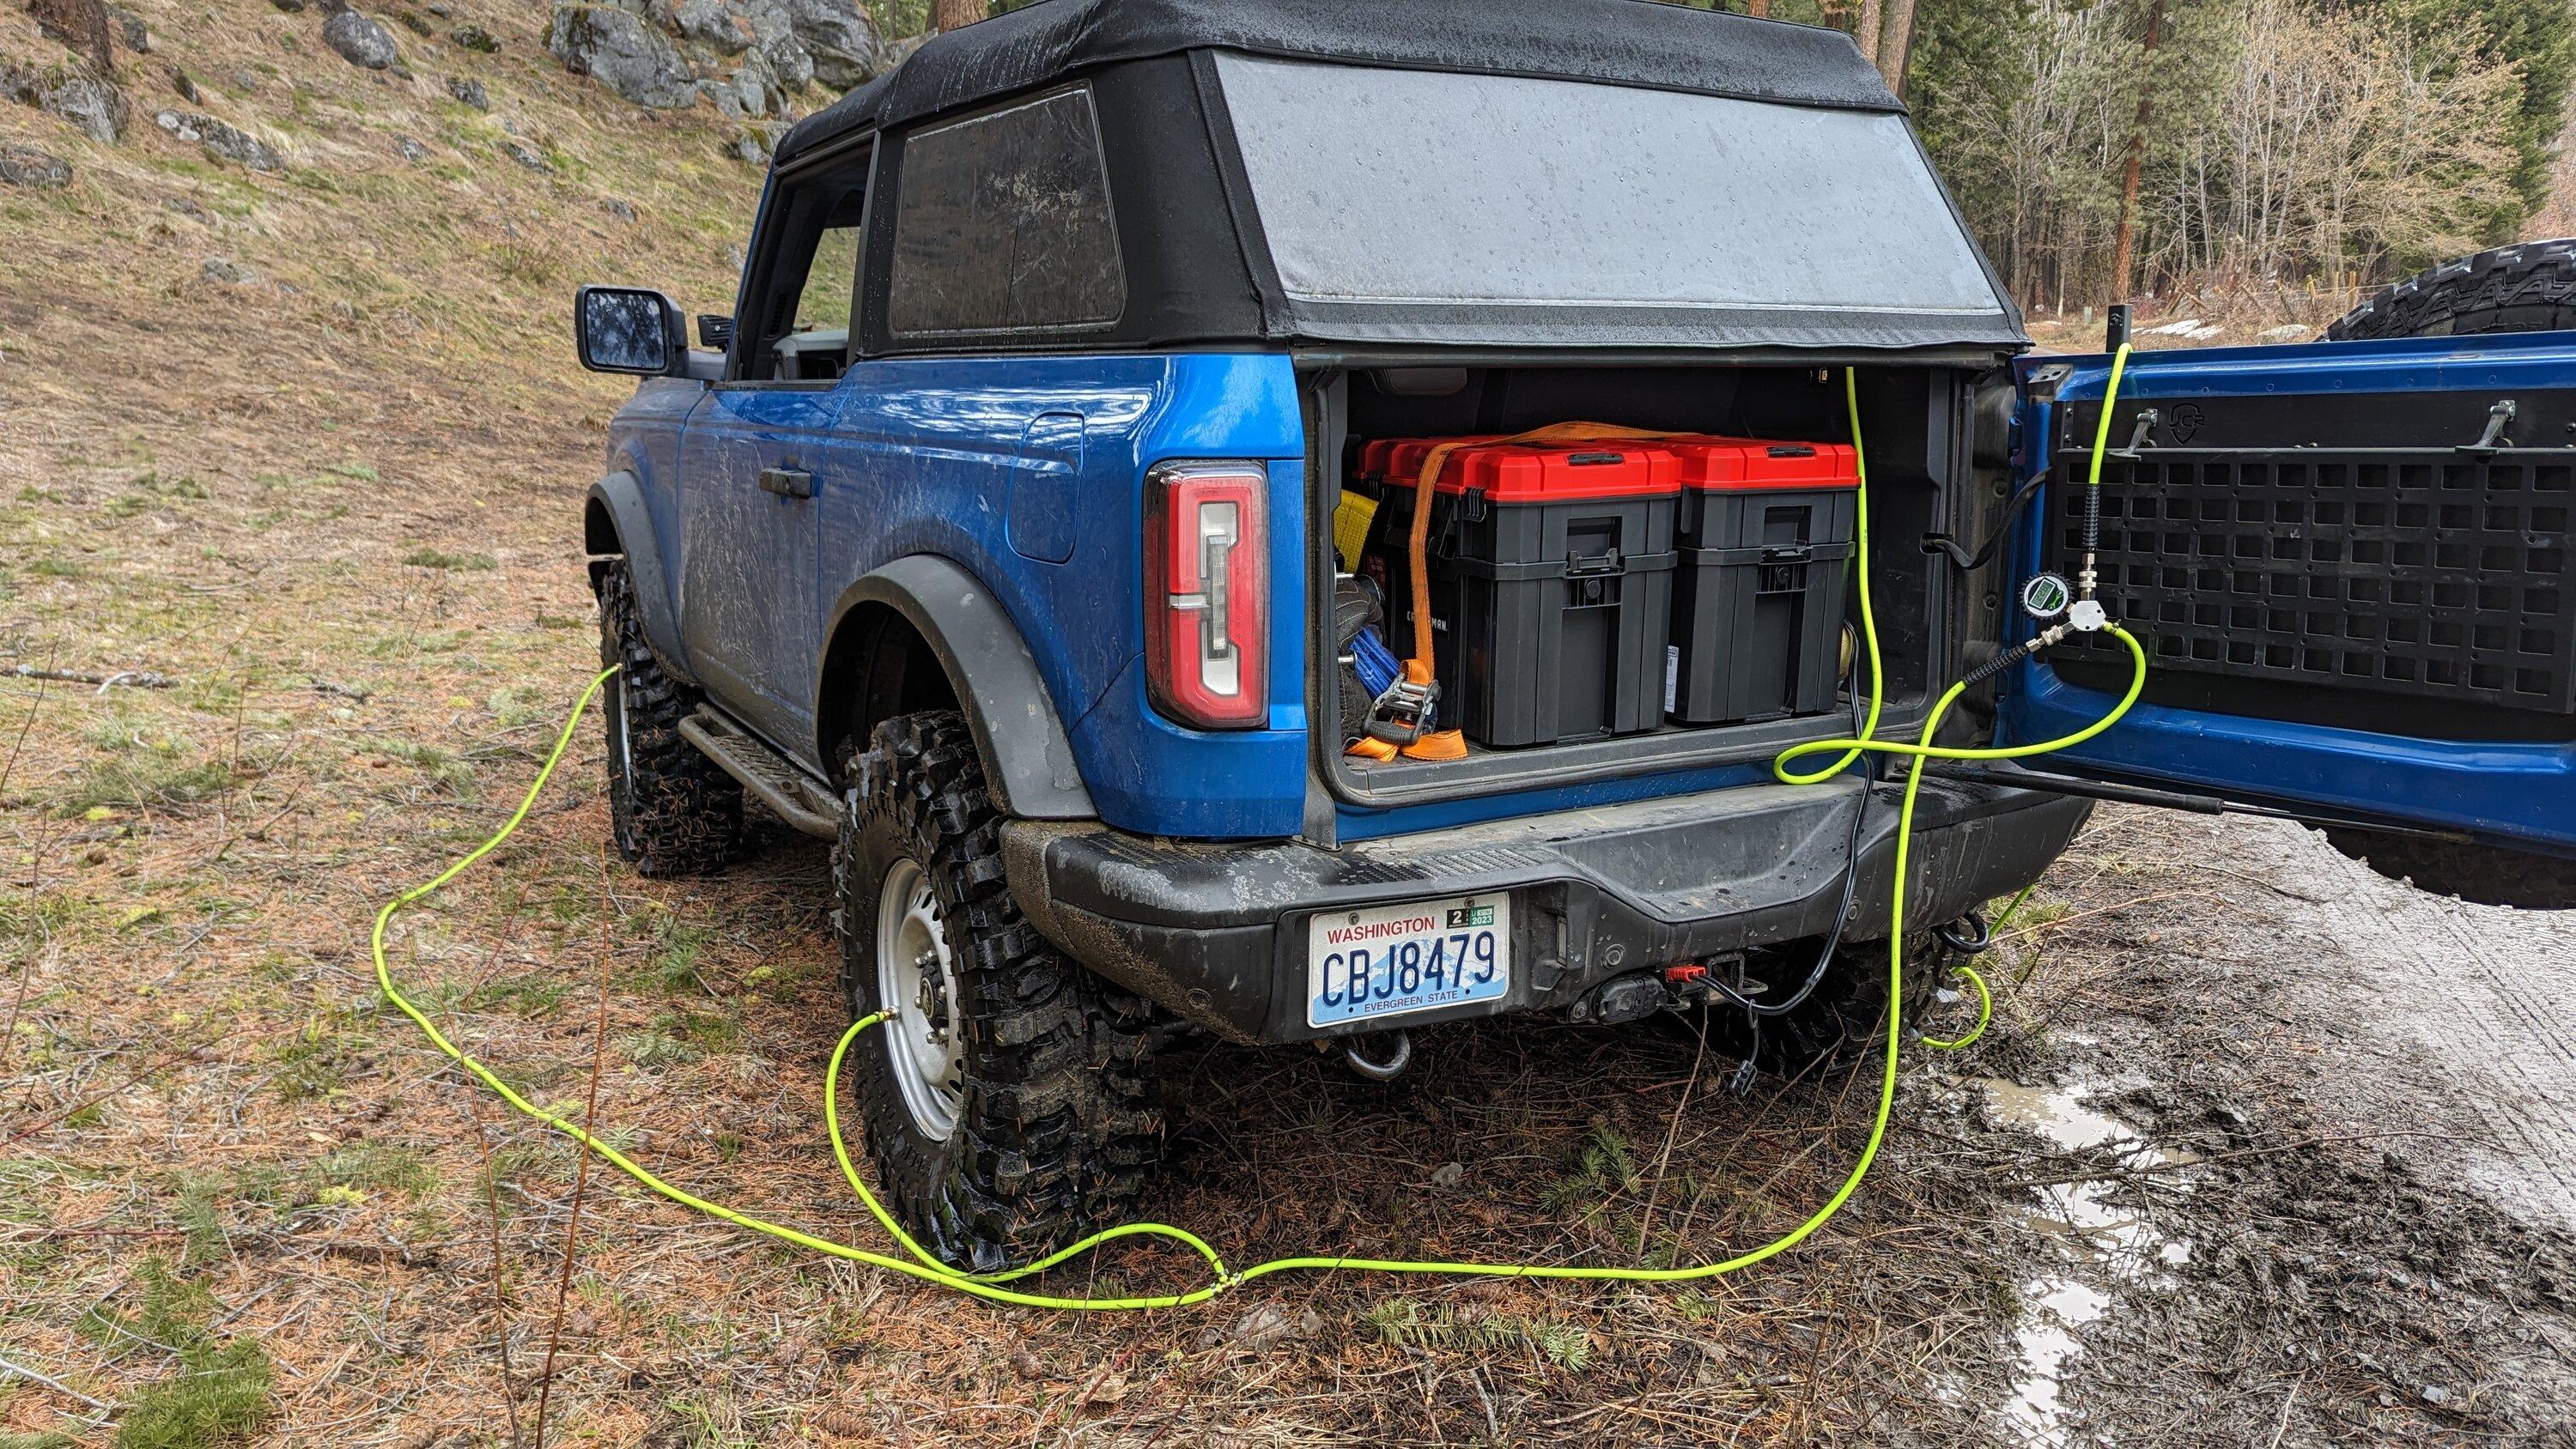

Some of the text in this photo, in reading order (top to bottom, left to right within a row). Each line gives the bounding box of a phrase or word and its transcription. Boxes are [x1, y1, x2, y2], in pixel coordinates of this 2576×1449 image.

[1452, 910, 1462, 925] 2
[1472, 915, 1492, 925] 2023
[1327, 916, 1435, 944] WASHINGTON
[1322, 931, 1495, 1007] CBJ8479
[1364, 990, 1458, 1013] EVERGREEN STATE
